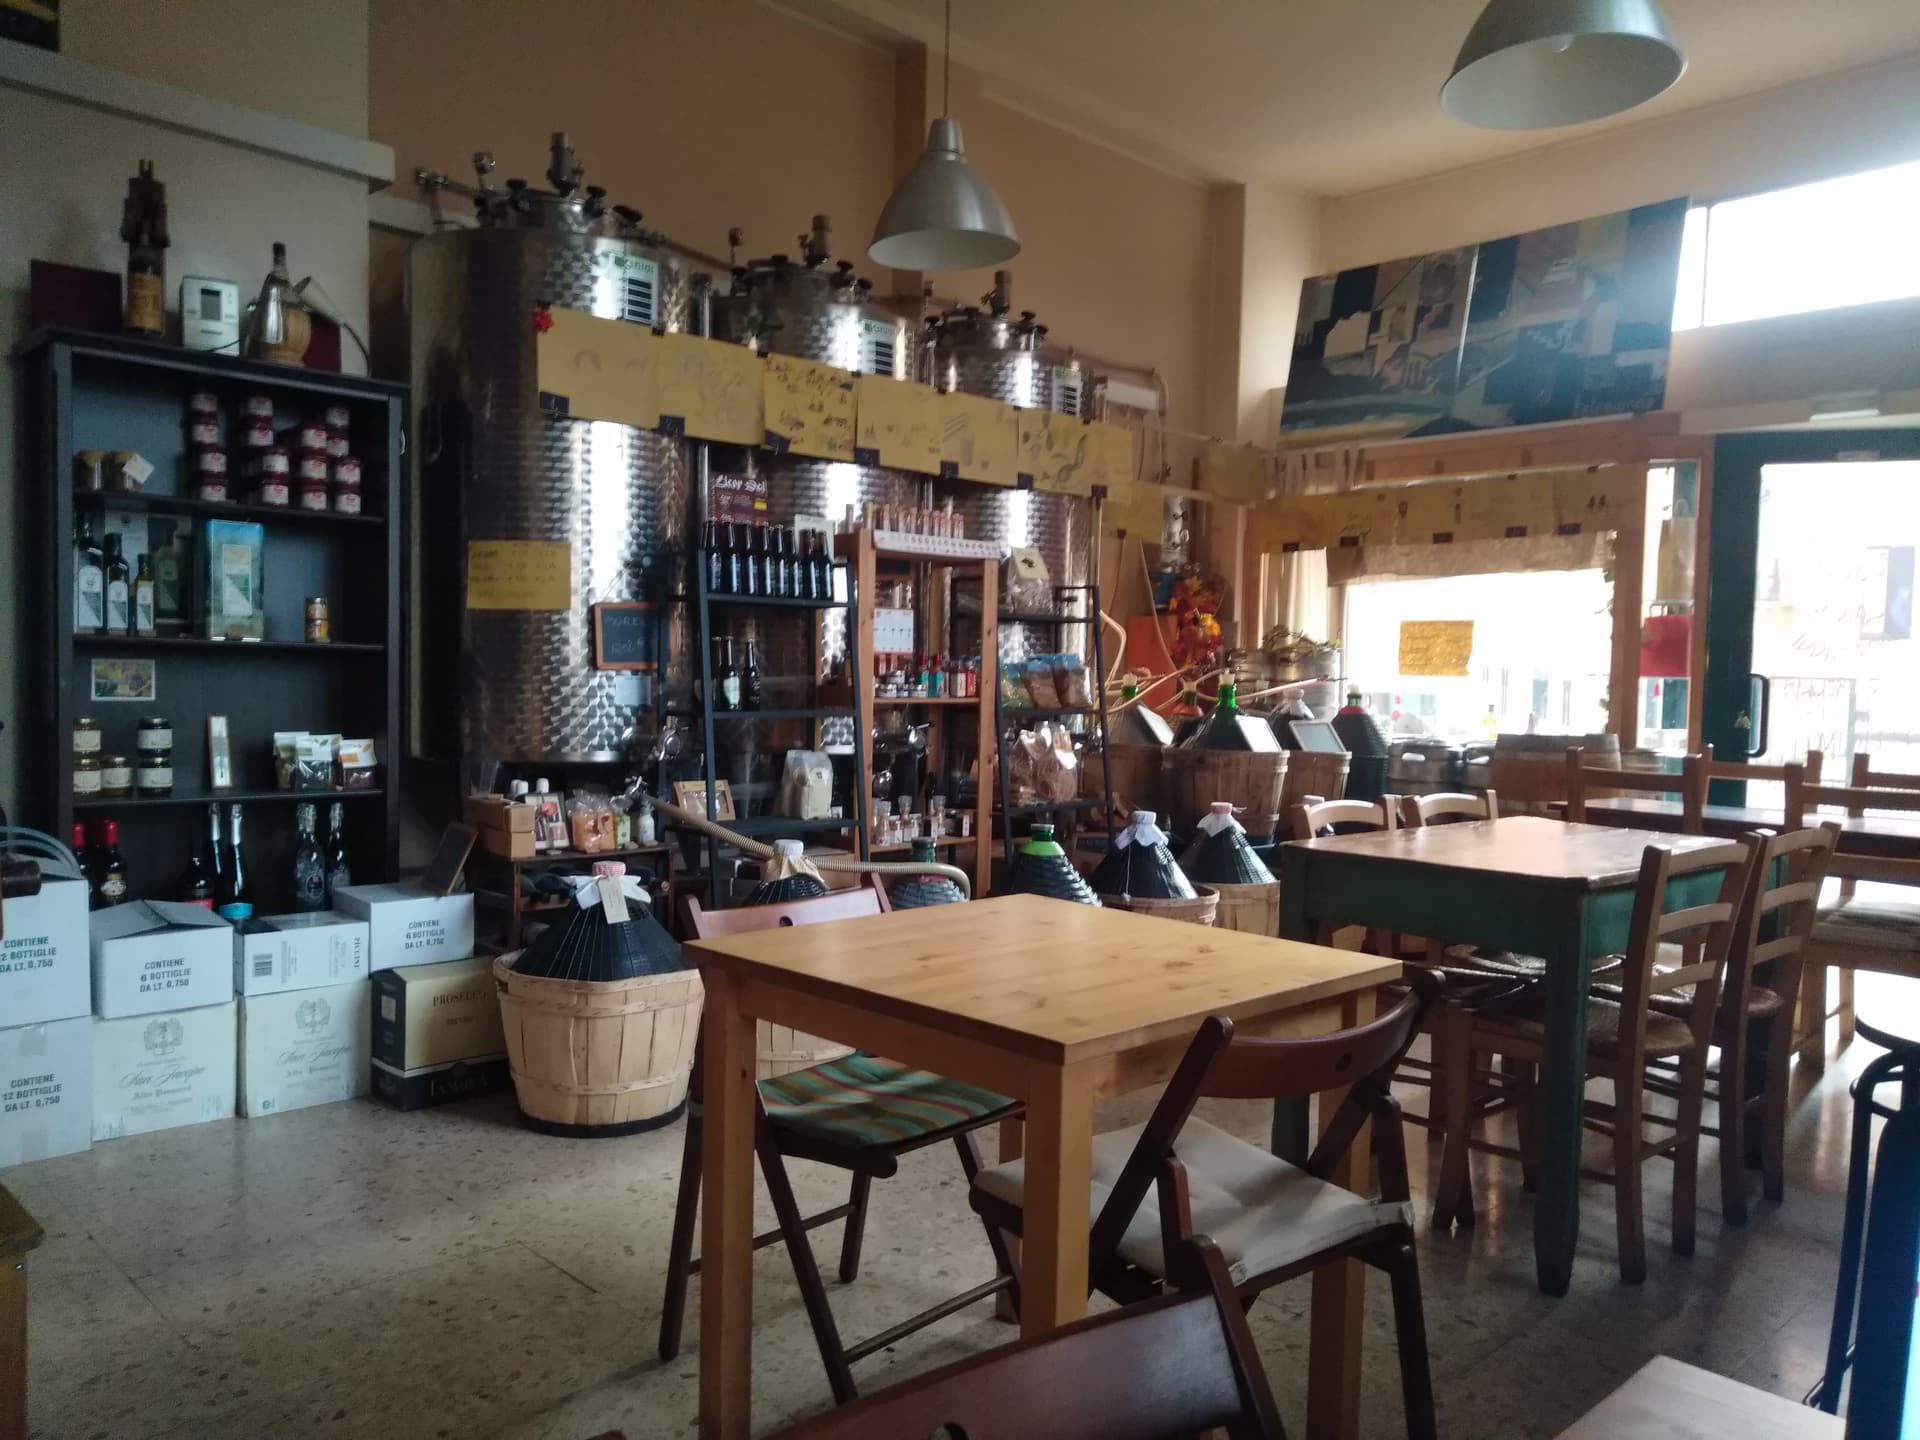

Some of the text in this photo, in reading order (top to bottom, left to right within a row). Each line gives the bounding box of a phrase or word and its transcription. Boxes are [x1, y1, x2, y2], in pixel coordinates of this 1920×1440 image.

[4, 936, 49, 949] CONTIENE
[0, 947, 57, 961] 2 BOTTIGLIE
[0, 964, 12, 973] DA
[144, 957, 185, 970] CONTIENE
[150, 967, 192, 981] BOTTIGLIE
[139, 984, 151, 992] DA
[10, 1073, 56, 1088] CONTIENE
[16, 1084, 63, 1100] BOTTIGLIE
[4, 1103, 18, 1112] DA
